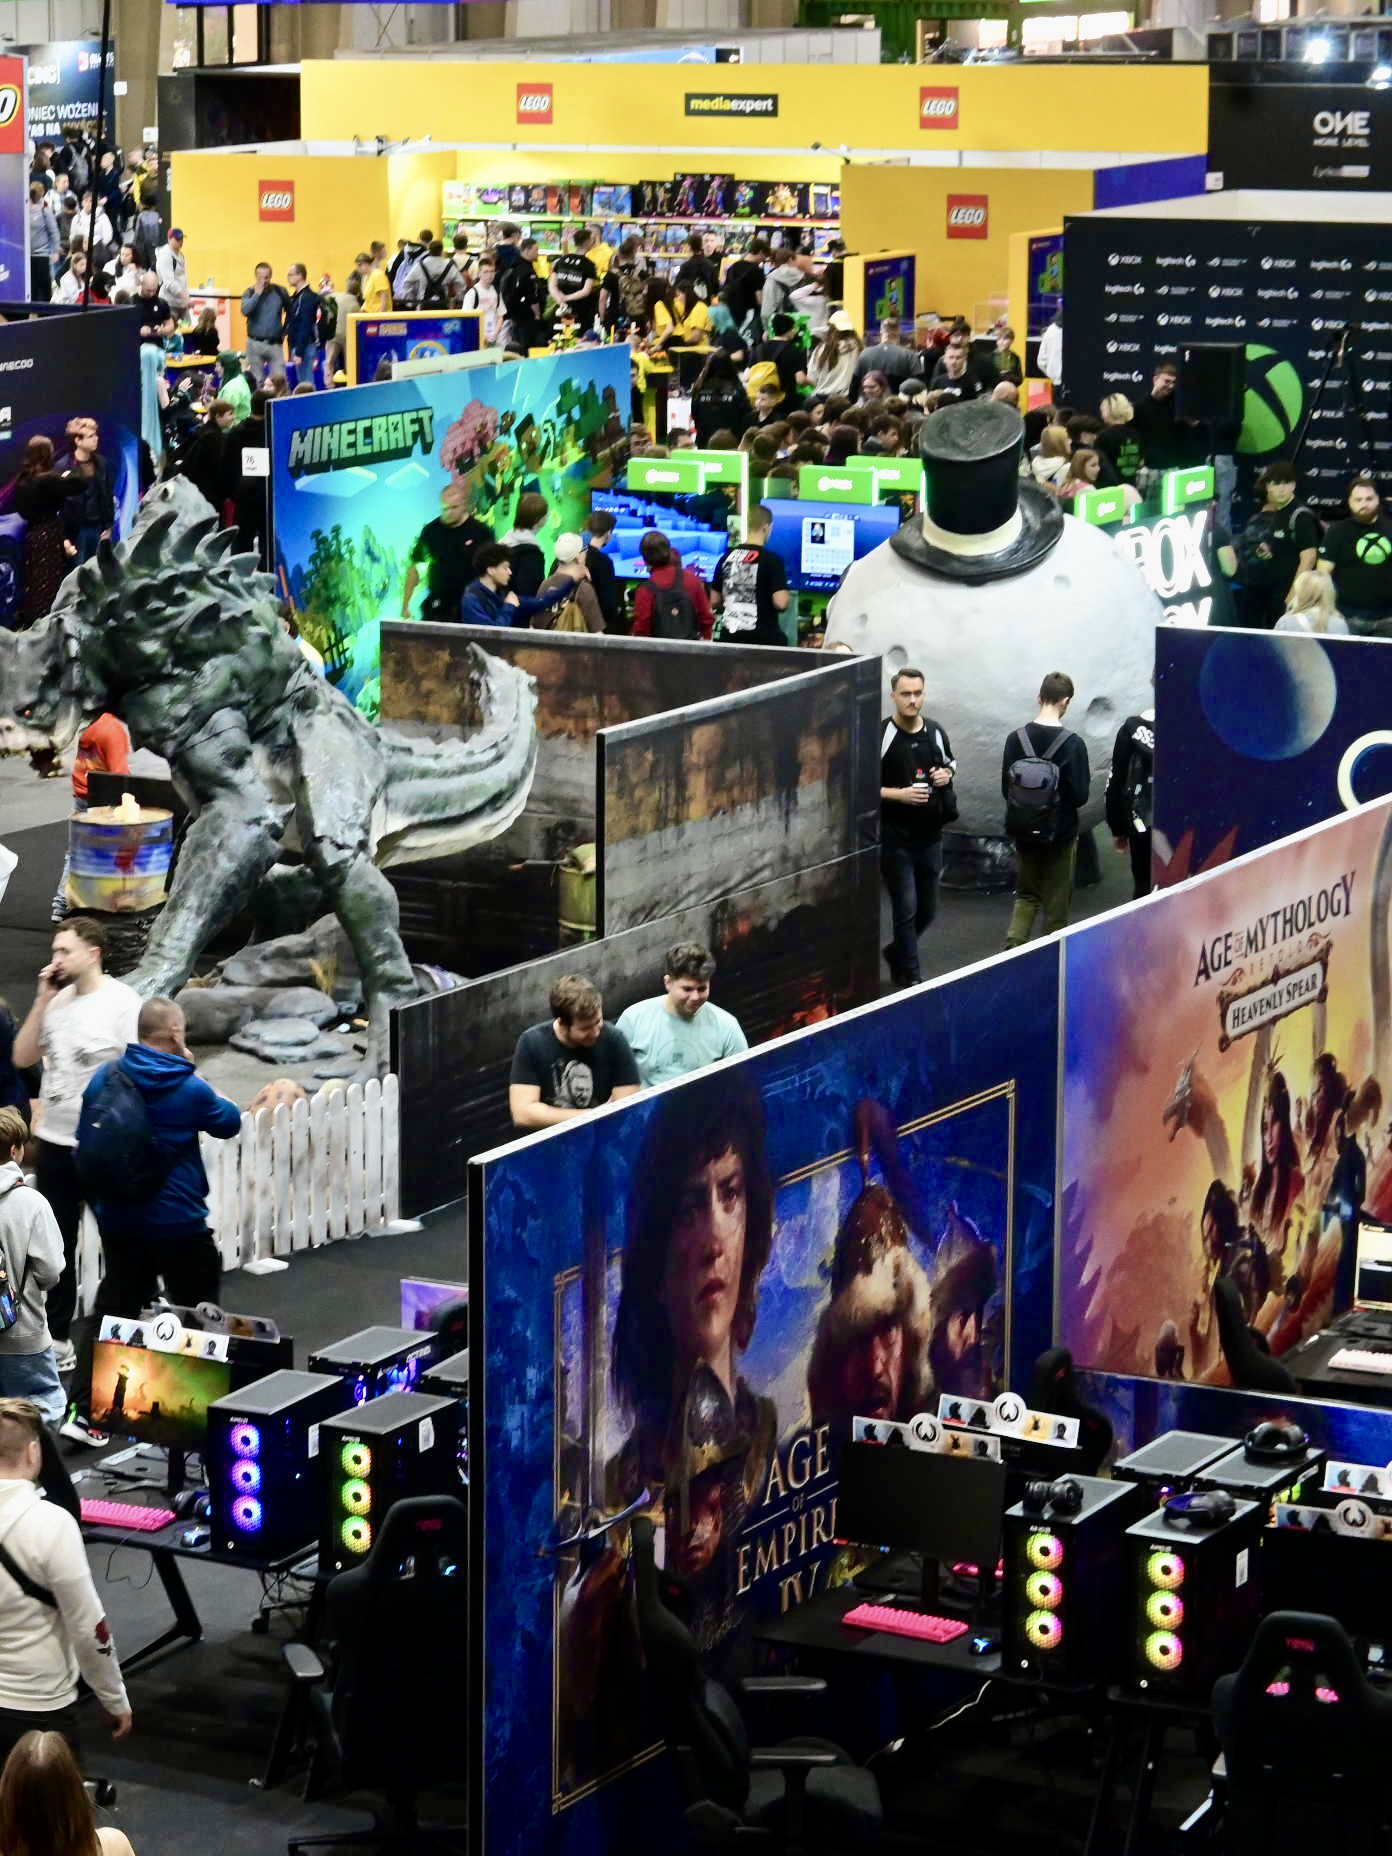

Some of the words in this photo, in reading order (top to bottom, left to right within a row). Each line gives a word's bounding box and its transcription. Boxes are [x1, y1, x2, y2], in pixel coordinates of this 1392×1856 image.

[56, 101, 99, 119] WOŻENI
[519, 94, 551, 112] LEGO
[689, 96, 774, 113] mediaexpert
[921, 98, 956, 117] LEGO
[1313, 111, 1370, 135] ONE
[261, 192, 292, 209] LEGO
[950, 206, 985, 226] LEGO
[288, 407, 435, 473] MINECRAFT
[1115, 510, 1212, 598] BOX
[1194, 931, 1234, 988] AGE
[1244, 870, 1356, 959] MYTHOLOGY
[1231, 988, 1284, 1030] HEAVENLY
[1285, 973, 1318, 1004] SPEAR
[762, 1424, 831, 1506] AGE
[736, 1498, 838, 1596] EMPIR
